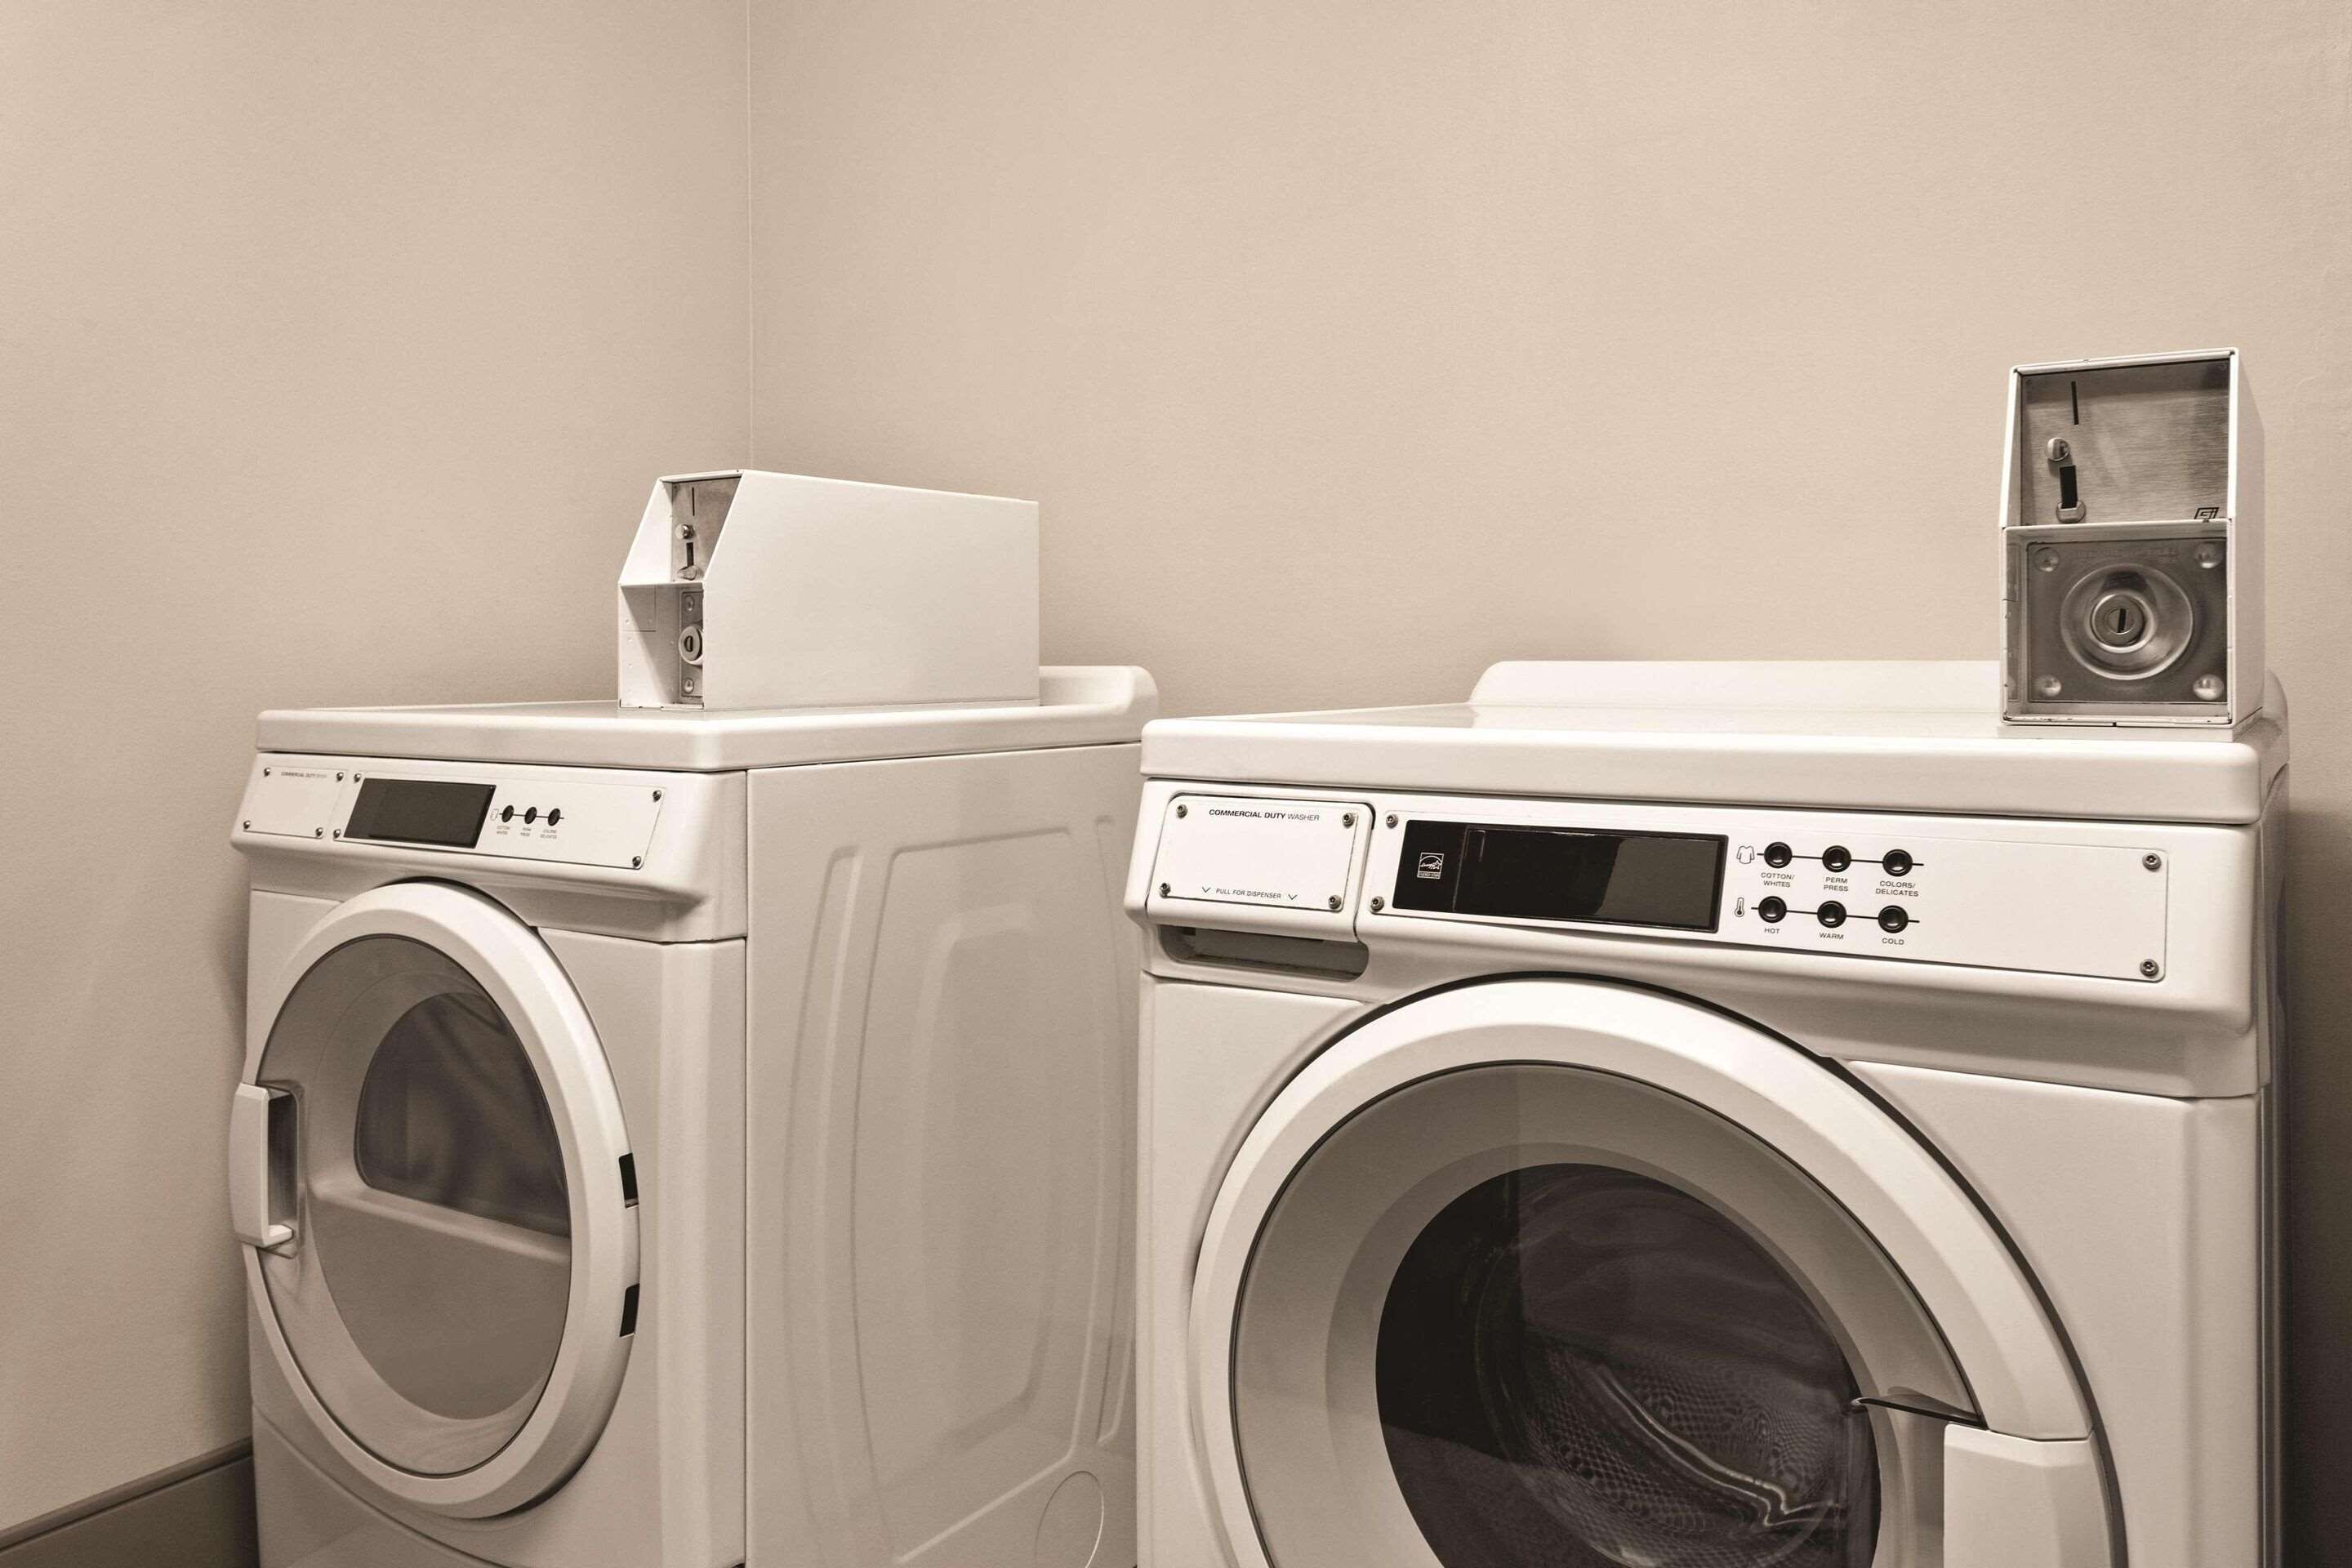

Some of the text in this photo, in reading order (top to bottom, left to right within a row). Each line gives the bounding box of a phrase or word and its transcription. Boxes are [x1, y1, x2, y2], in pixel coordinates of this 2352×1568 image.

[1209, 808, 1263, 818] COMMERCIAL
[1287, 813, 1321, 822] WASHER
[1761, 872, 1795, 880] COTTON/
[1825, 876, 1848, 884] PERM
[1763, 880, 1791, 888] WHITES
[1823, 884, 1849, 893] PRESS
[1879, 880, 1916, 889] COLORS/
[1246, 891, 1281, 899] DISPENSER
[1875, 888, 1919, 898] DELICATES
[1763, 927, 1780, 935] HOT
[1819, 932, 1844, 941] WARM
[1882, 937, 1904, 946] COLD
